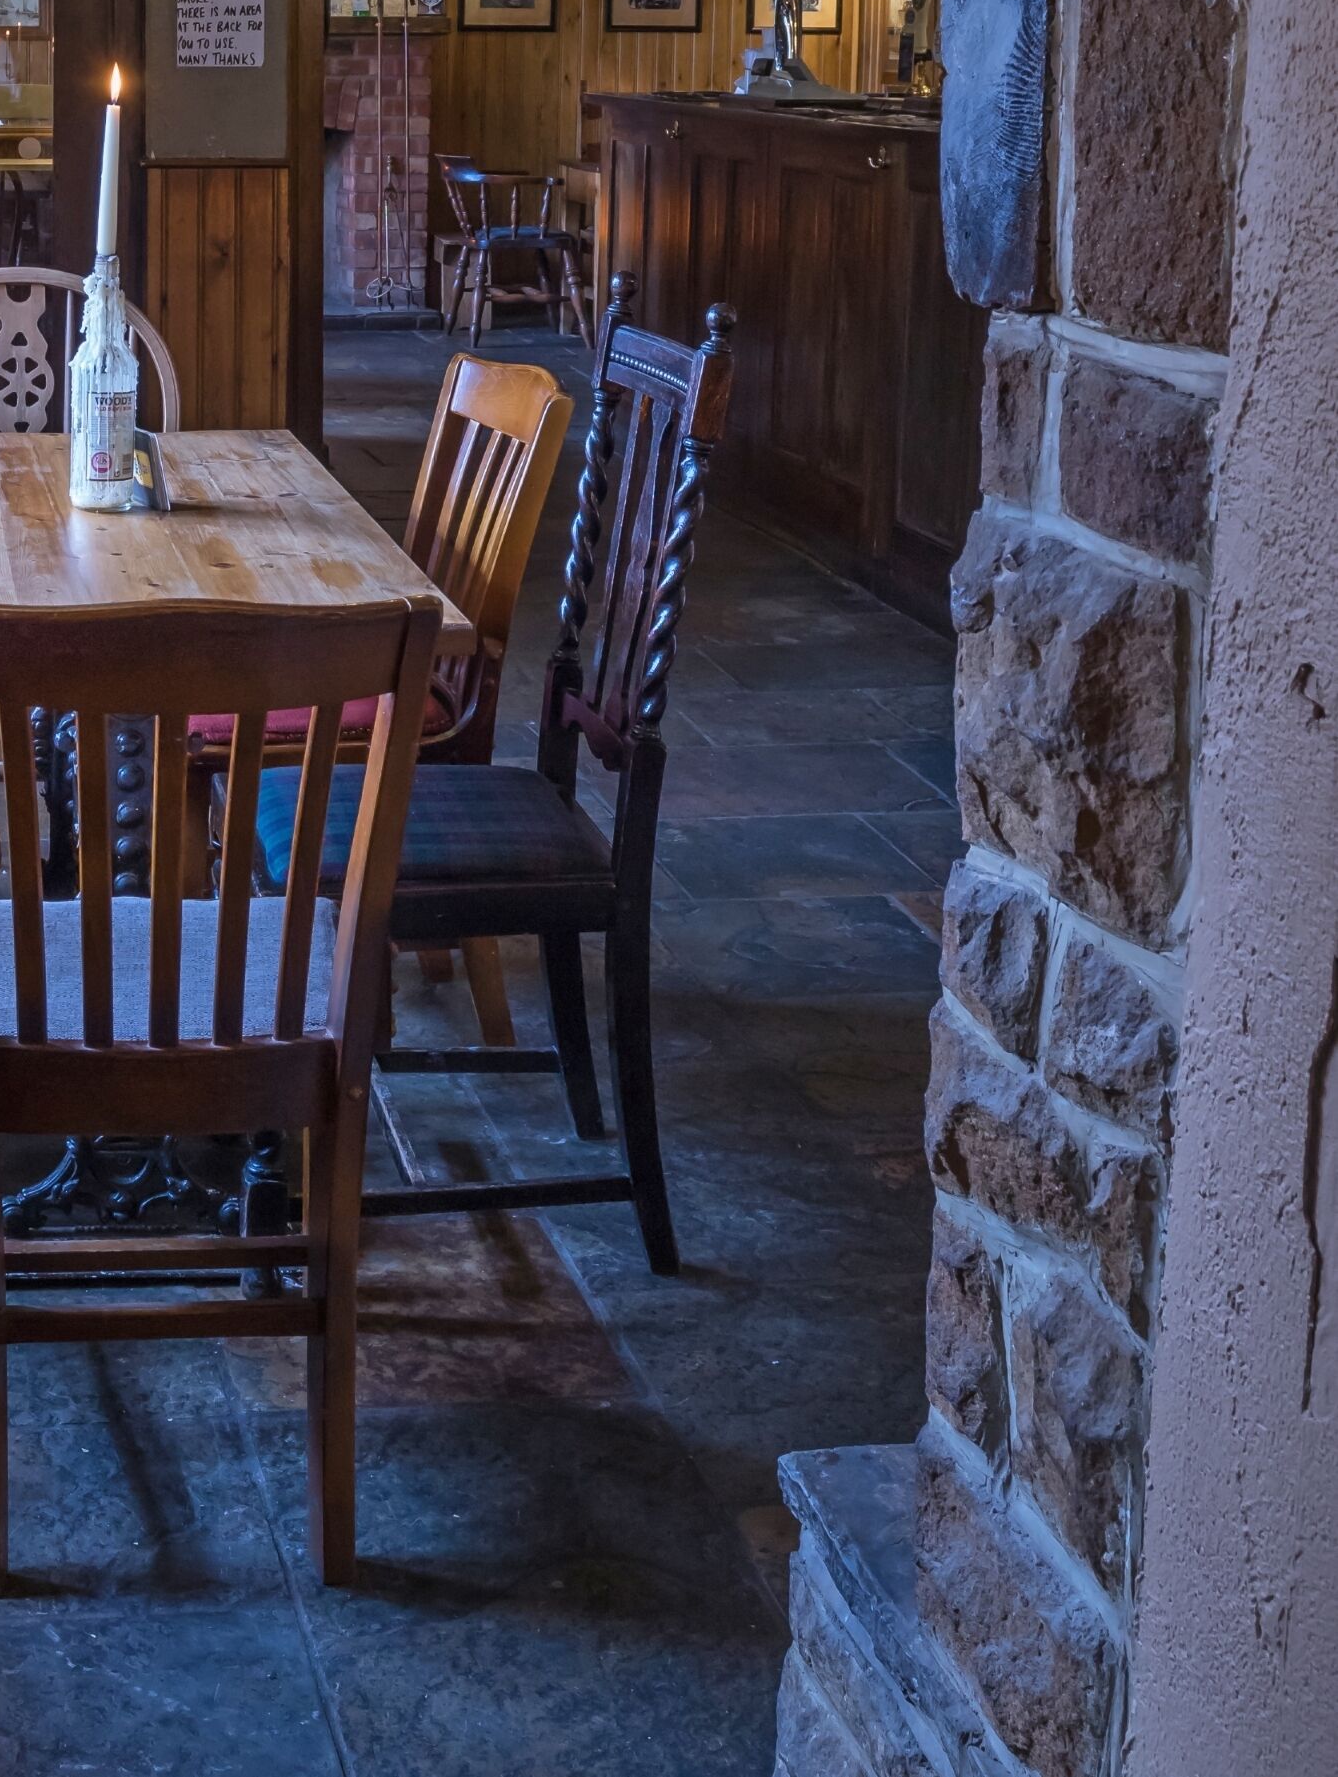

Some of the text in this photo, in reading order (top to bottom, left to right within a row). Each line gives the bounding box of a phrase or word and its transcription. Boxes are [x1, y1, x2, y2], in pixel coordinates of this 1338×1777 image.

[177, 4, 262, 19] THERE IS AN AREA
[193, 22, 213, 33] THE
[217, 21, 242, 33] BACK
[247, 20, 263, 31] FOR
[197, 38, 210, 49] TO
[178, 52, 256, 65] MANY THANKS
